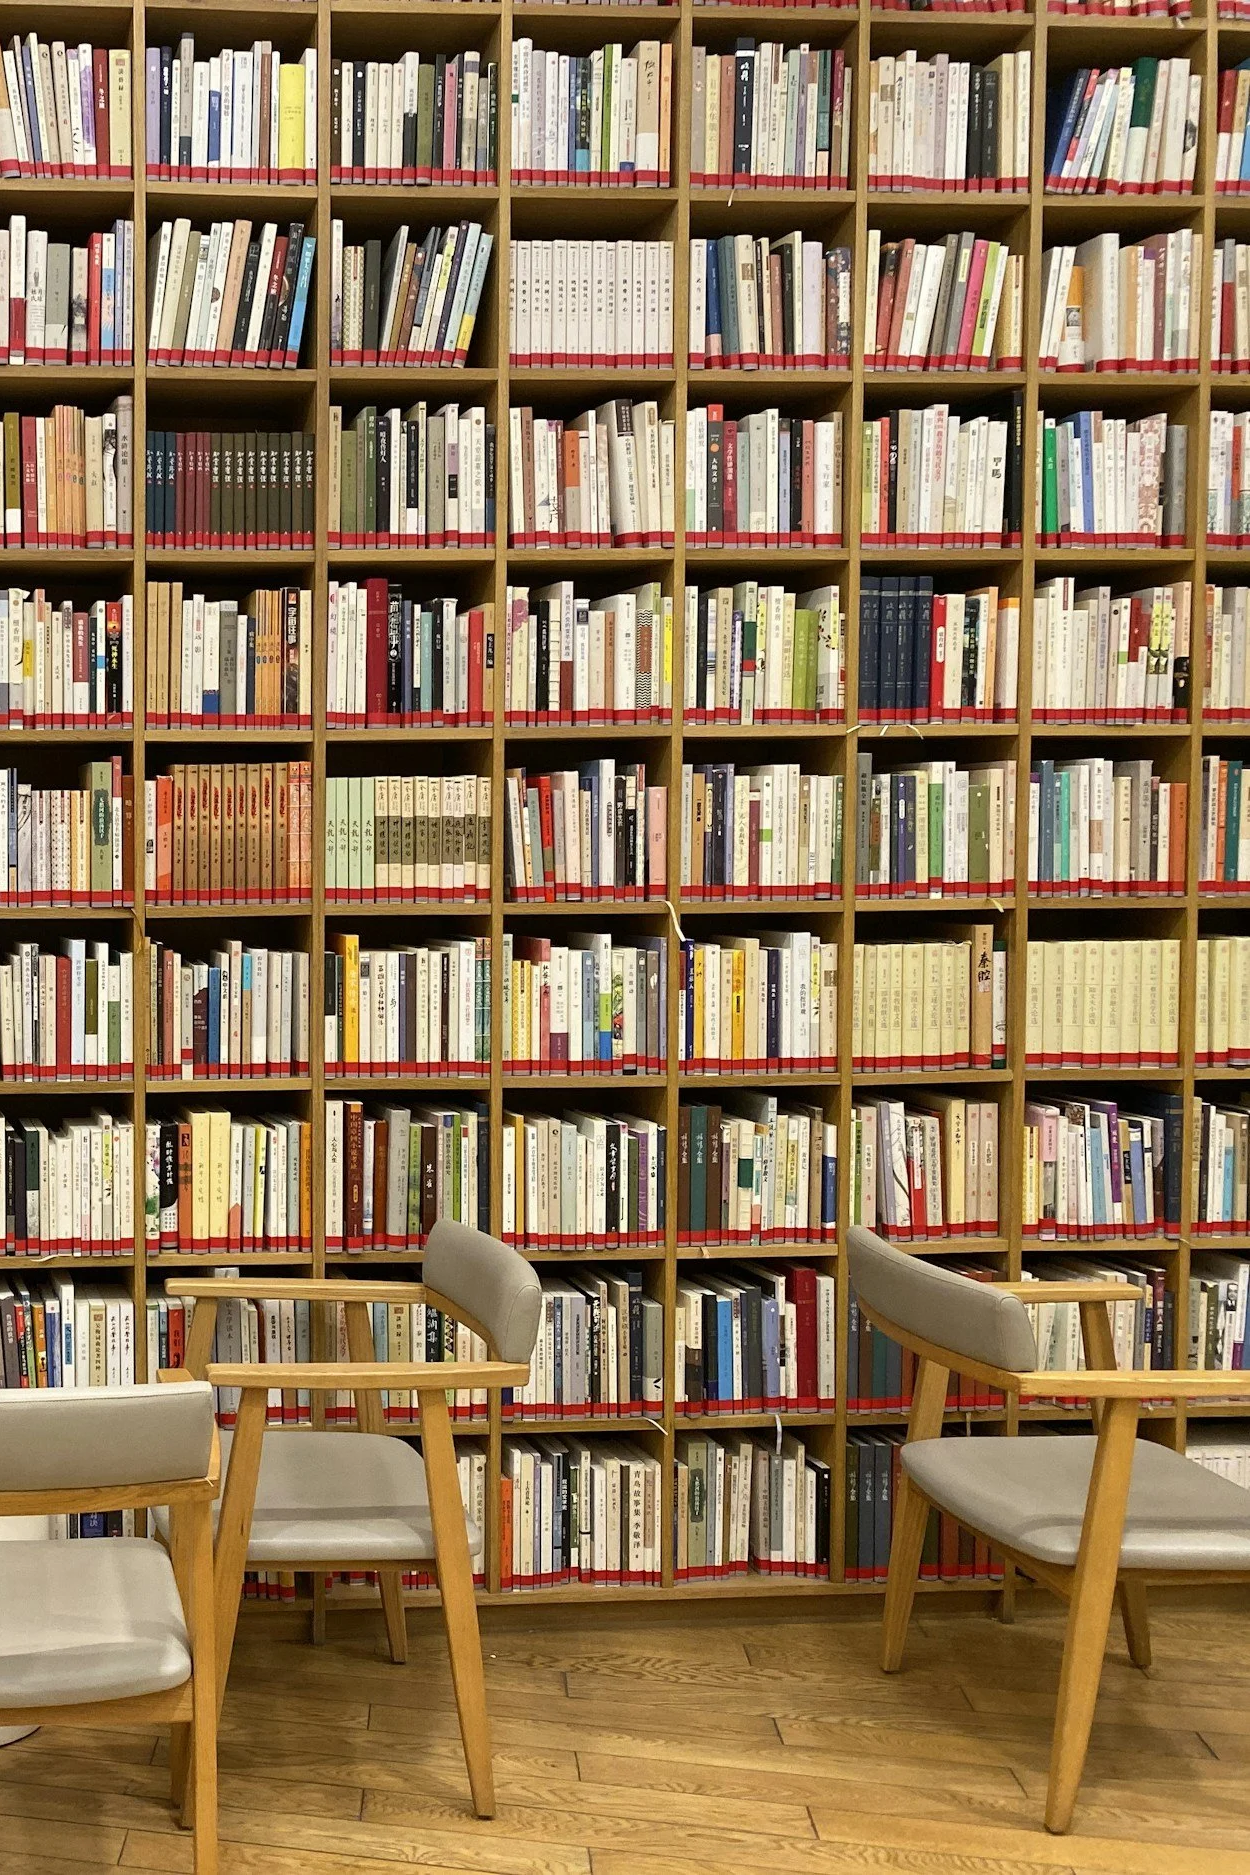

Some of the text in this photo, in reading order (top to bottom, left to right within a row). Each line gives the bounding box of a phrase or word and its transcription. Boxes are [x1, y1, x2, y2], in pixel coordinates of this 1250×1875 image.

[120, 434, 128, 466] 水浒论集
[977, 951, 992, 983] 秦腔
[426, 1163, 435, 1188] 朱雀
[634, 1470, 642, 1517] 青鸟故事集
[633, 1521, 642, 1549] 李敬泽
